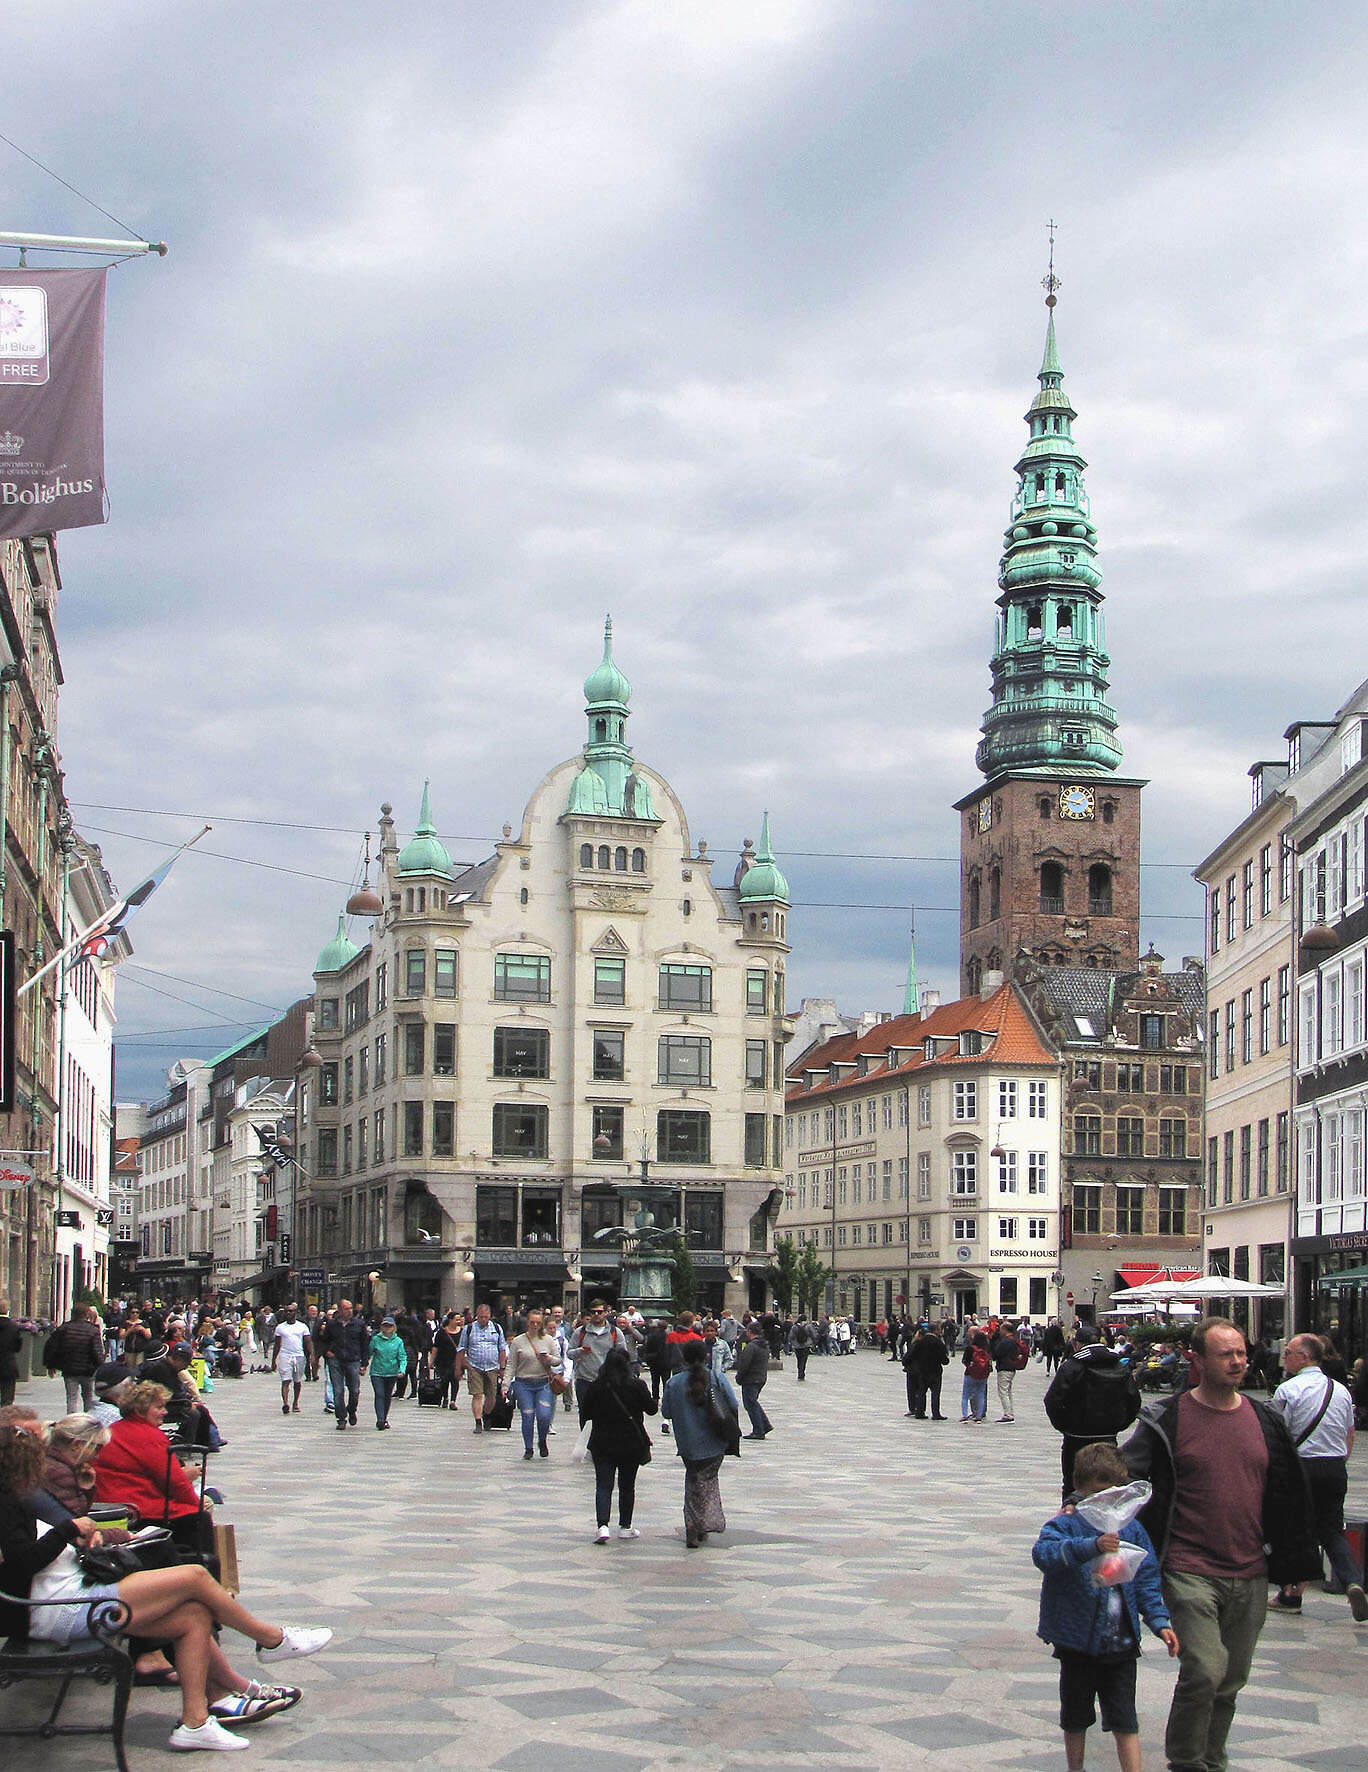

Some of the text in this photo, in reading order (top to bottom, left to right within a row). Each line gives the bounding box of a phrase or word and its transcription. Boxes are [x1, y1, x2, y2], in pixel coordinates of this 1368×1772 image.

[10, 342, 36, 352] Blue
[2, 364, 39, 377] FREE
[1, 477, 93, 504] Bolighus
[264, 1143, 291, 1168] HAY
[990, 1249, 1057, 1258] ESPRESSO HOUSE
